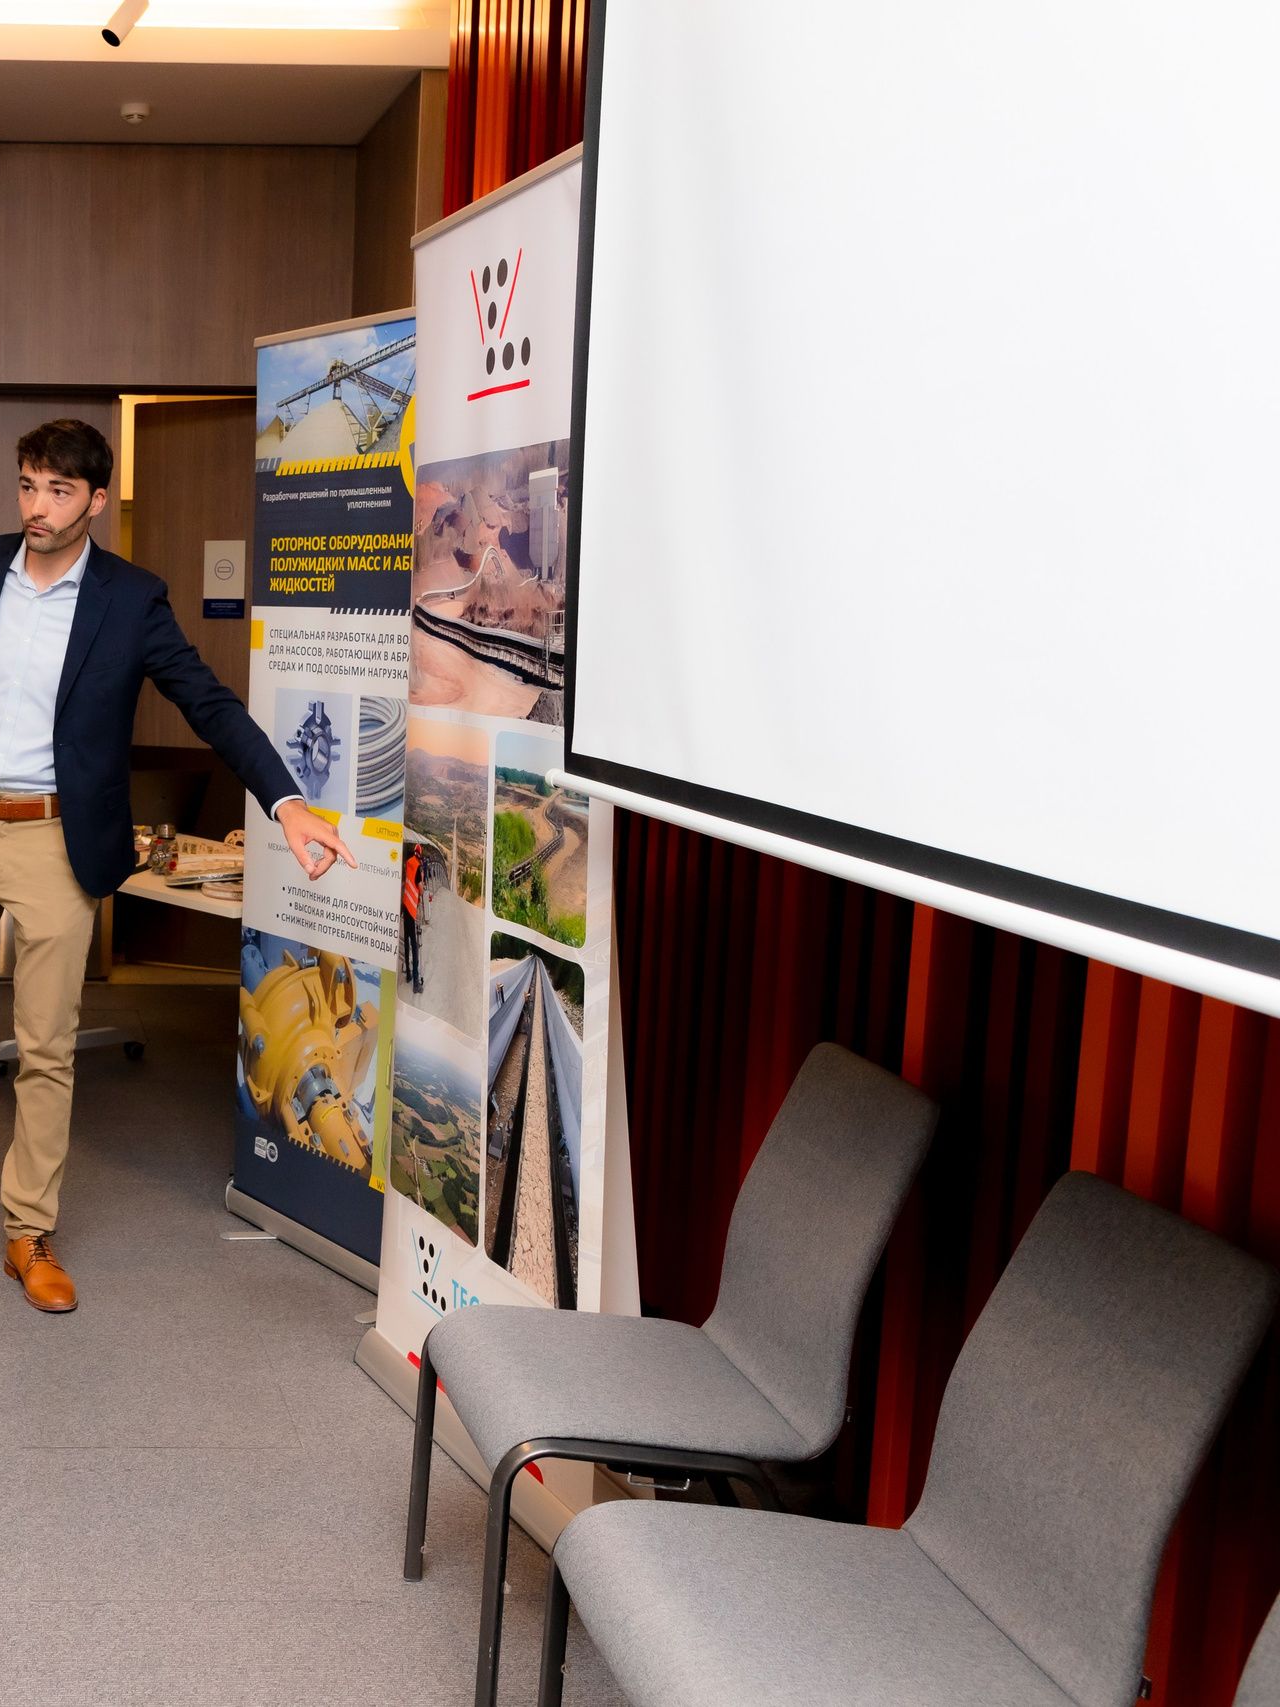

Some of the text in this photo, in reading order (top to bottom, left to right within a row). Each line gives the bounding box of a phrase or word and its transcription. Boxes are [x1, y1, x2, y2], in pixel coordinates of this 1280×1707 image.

[263, 485, 392, 502] Разработчик решений по промышленным
[347, 500, 391, 511] уплотнениям
[271, 533, 413, 552] РОТОРНОЕ ОБОРУДОВАНИ
[270, 556, 345, 574] ПОЛУЖИДКИХ
[347, 556, 380, 571] МАСС
[383, 556, 391, 571] И
[270, 574, 335, 595] ЖИДКОСТЕЙ
[270, 629, 410, 647] СПЕЦИАЛЬНАЯ РАЗРАБОТКА ДЛЯ ВО
[269, 644, 284, 655] ДЛЯ
[286, 646, 325, 658] НАСОСОВ,
[326, 648, 382, 662] РАБОТАЮЩИХ
[383, 651, 389, 661] В
[269, 660, 409, 680] СРЕДАХ И ПОД ОСОБЫМИ НАГРУЗКА
[359, 862, 390, 876] ПЛЕТЕНЫЙ
[287, 885, 331, 905] УПЛОТНЕНИЯ
[332, 897, 348, 909] ДЛЯ
[349, 901, 383, 919] СУРОВЫХ
[294, 901, 325, 918] ВЫСОКАЯ
[281, 912, 317, 931] СНИЖЕНИЕ
[318, 923, 369, 946] ПОТРЕБЛЕНИЯ
[370, 938, 392, 953] ВОДЫ
